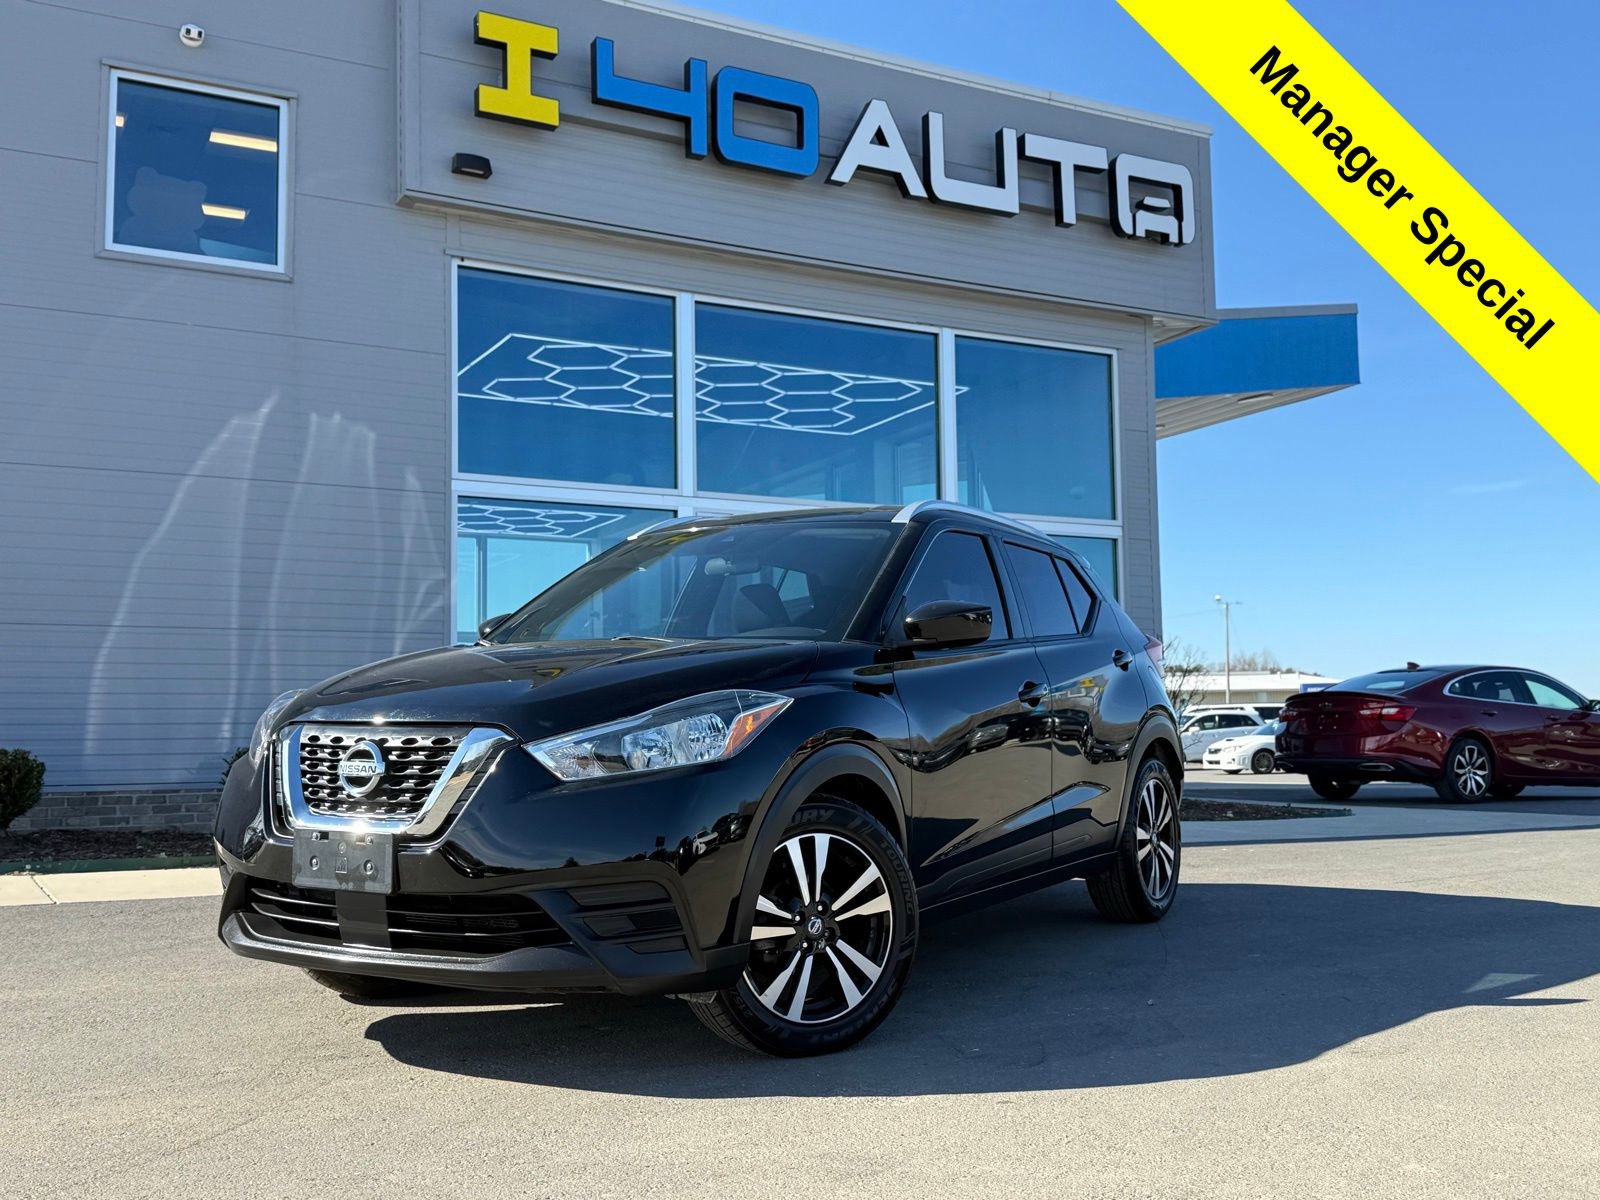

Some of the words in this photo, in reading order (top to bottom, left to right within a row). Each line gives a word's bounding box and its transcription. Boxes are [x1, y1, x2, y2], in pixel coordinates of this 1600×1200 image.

[475, 12, 560, 128] I
[592, 37, 820, 178] 40
[340, 764, 377, 774] NISSAN
[880, 839, 916, 914] TOURING
